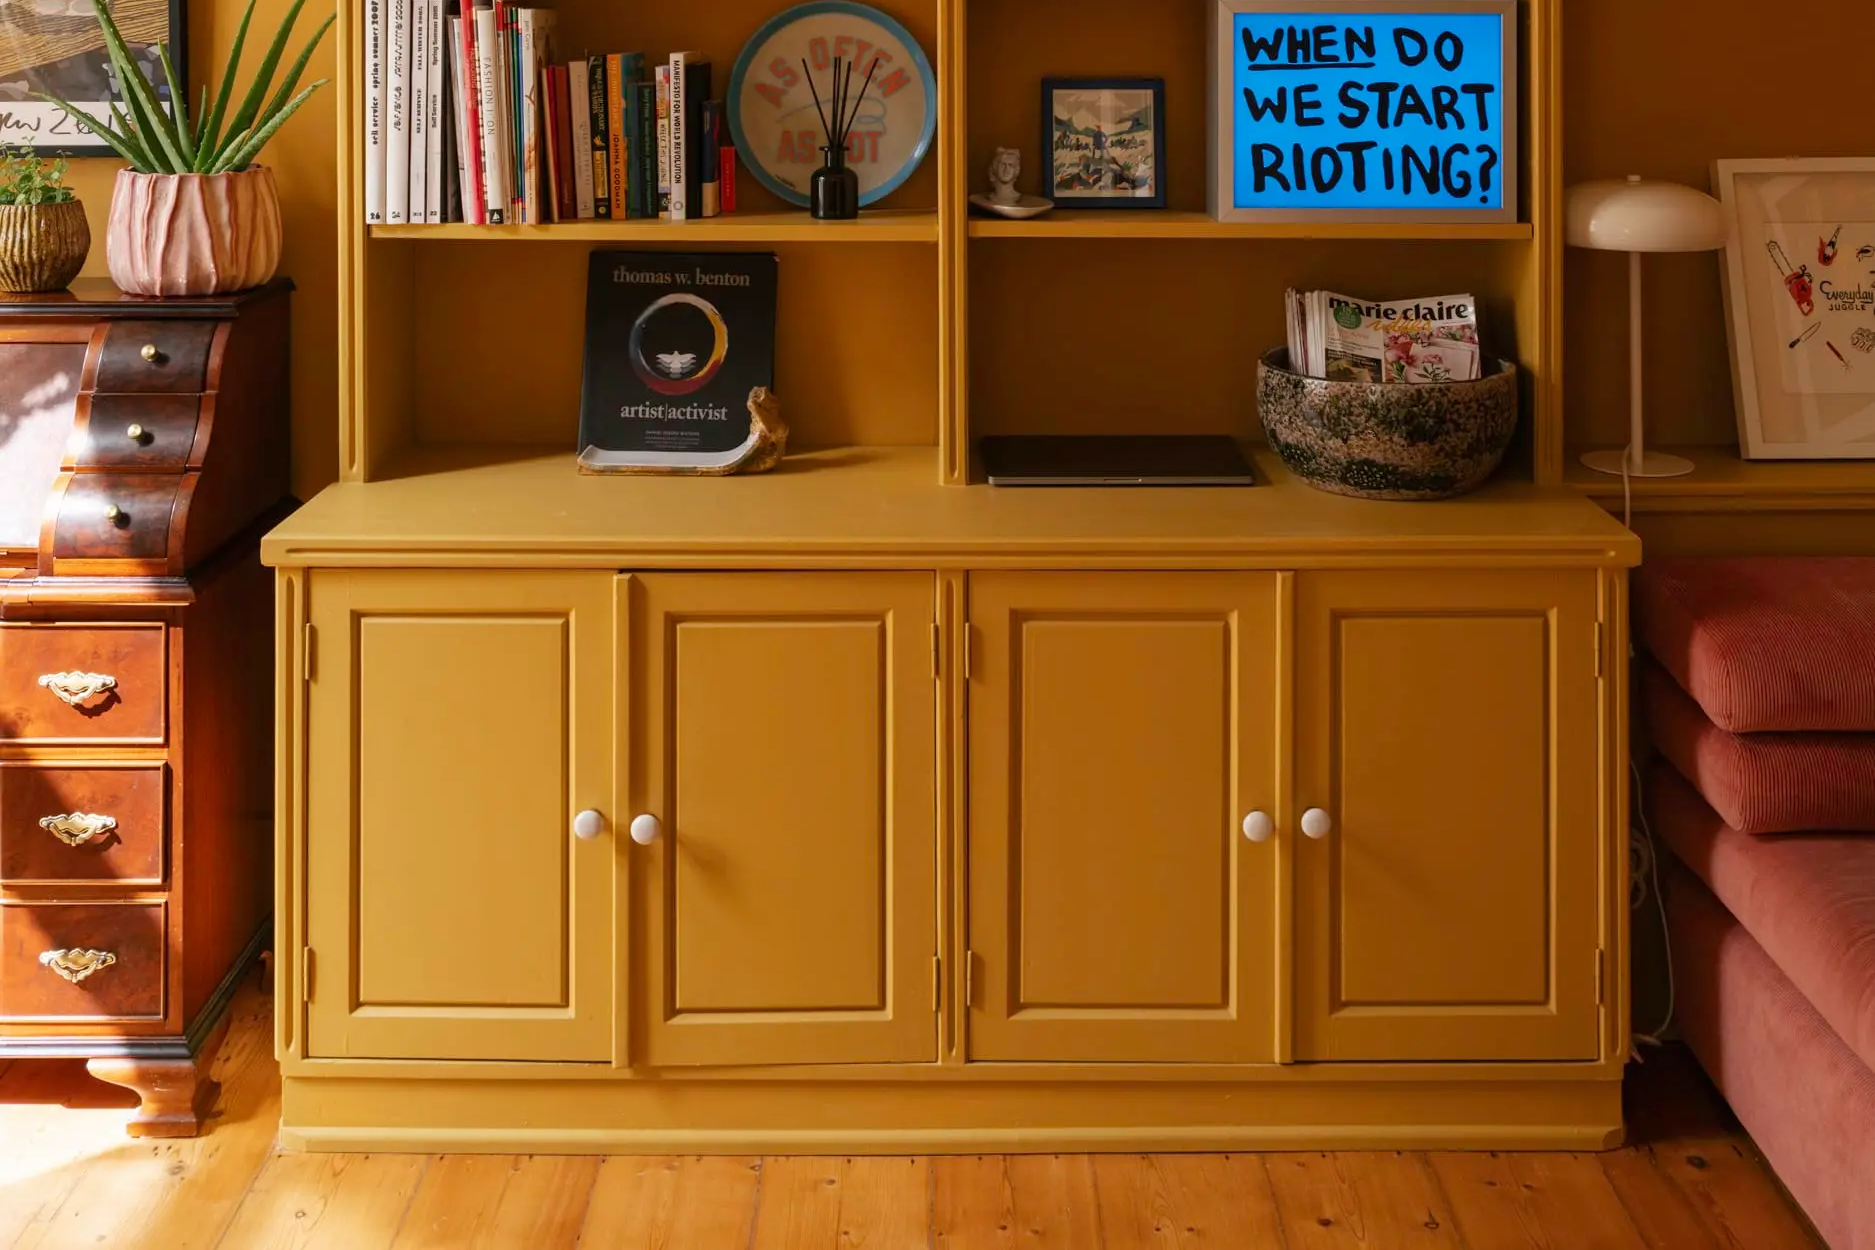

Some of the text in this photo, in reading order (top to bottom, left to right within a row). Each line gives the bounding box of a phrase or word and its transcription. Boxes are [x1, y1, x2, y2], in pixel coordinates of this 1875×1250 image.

[371, 27, 379, 59] summer
[1242, 25, 1463, 71] WHEN DO
[371, 62, 380, 89] spring
[483, 57, 494, 104] FASHION
[755, 35, 911, 108] AS OFTEN
[1243, 81, 1495, 131] WE START
[613, 133, 621, 164] JOANNA
[673, 142, 681, 184] REVOLUTION
[776, 130, 816, 164] AS
[1251, 140, 1497, 204] RIOTING?
[613, 266, 750, 286] thomas w. benton
[1402, 301, 1469, 321] claire
[1828, 302, 1867, 312] JUGGLE
